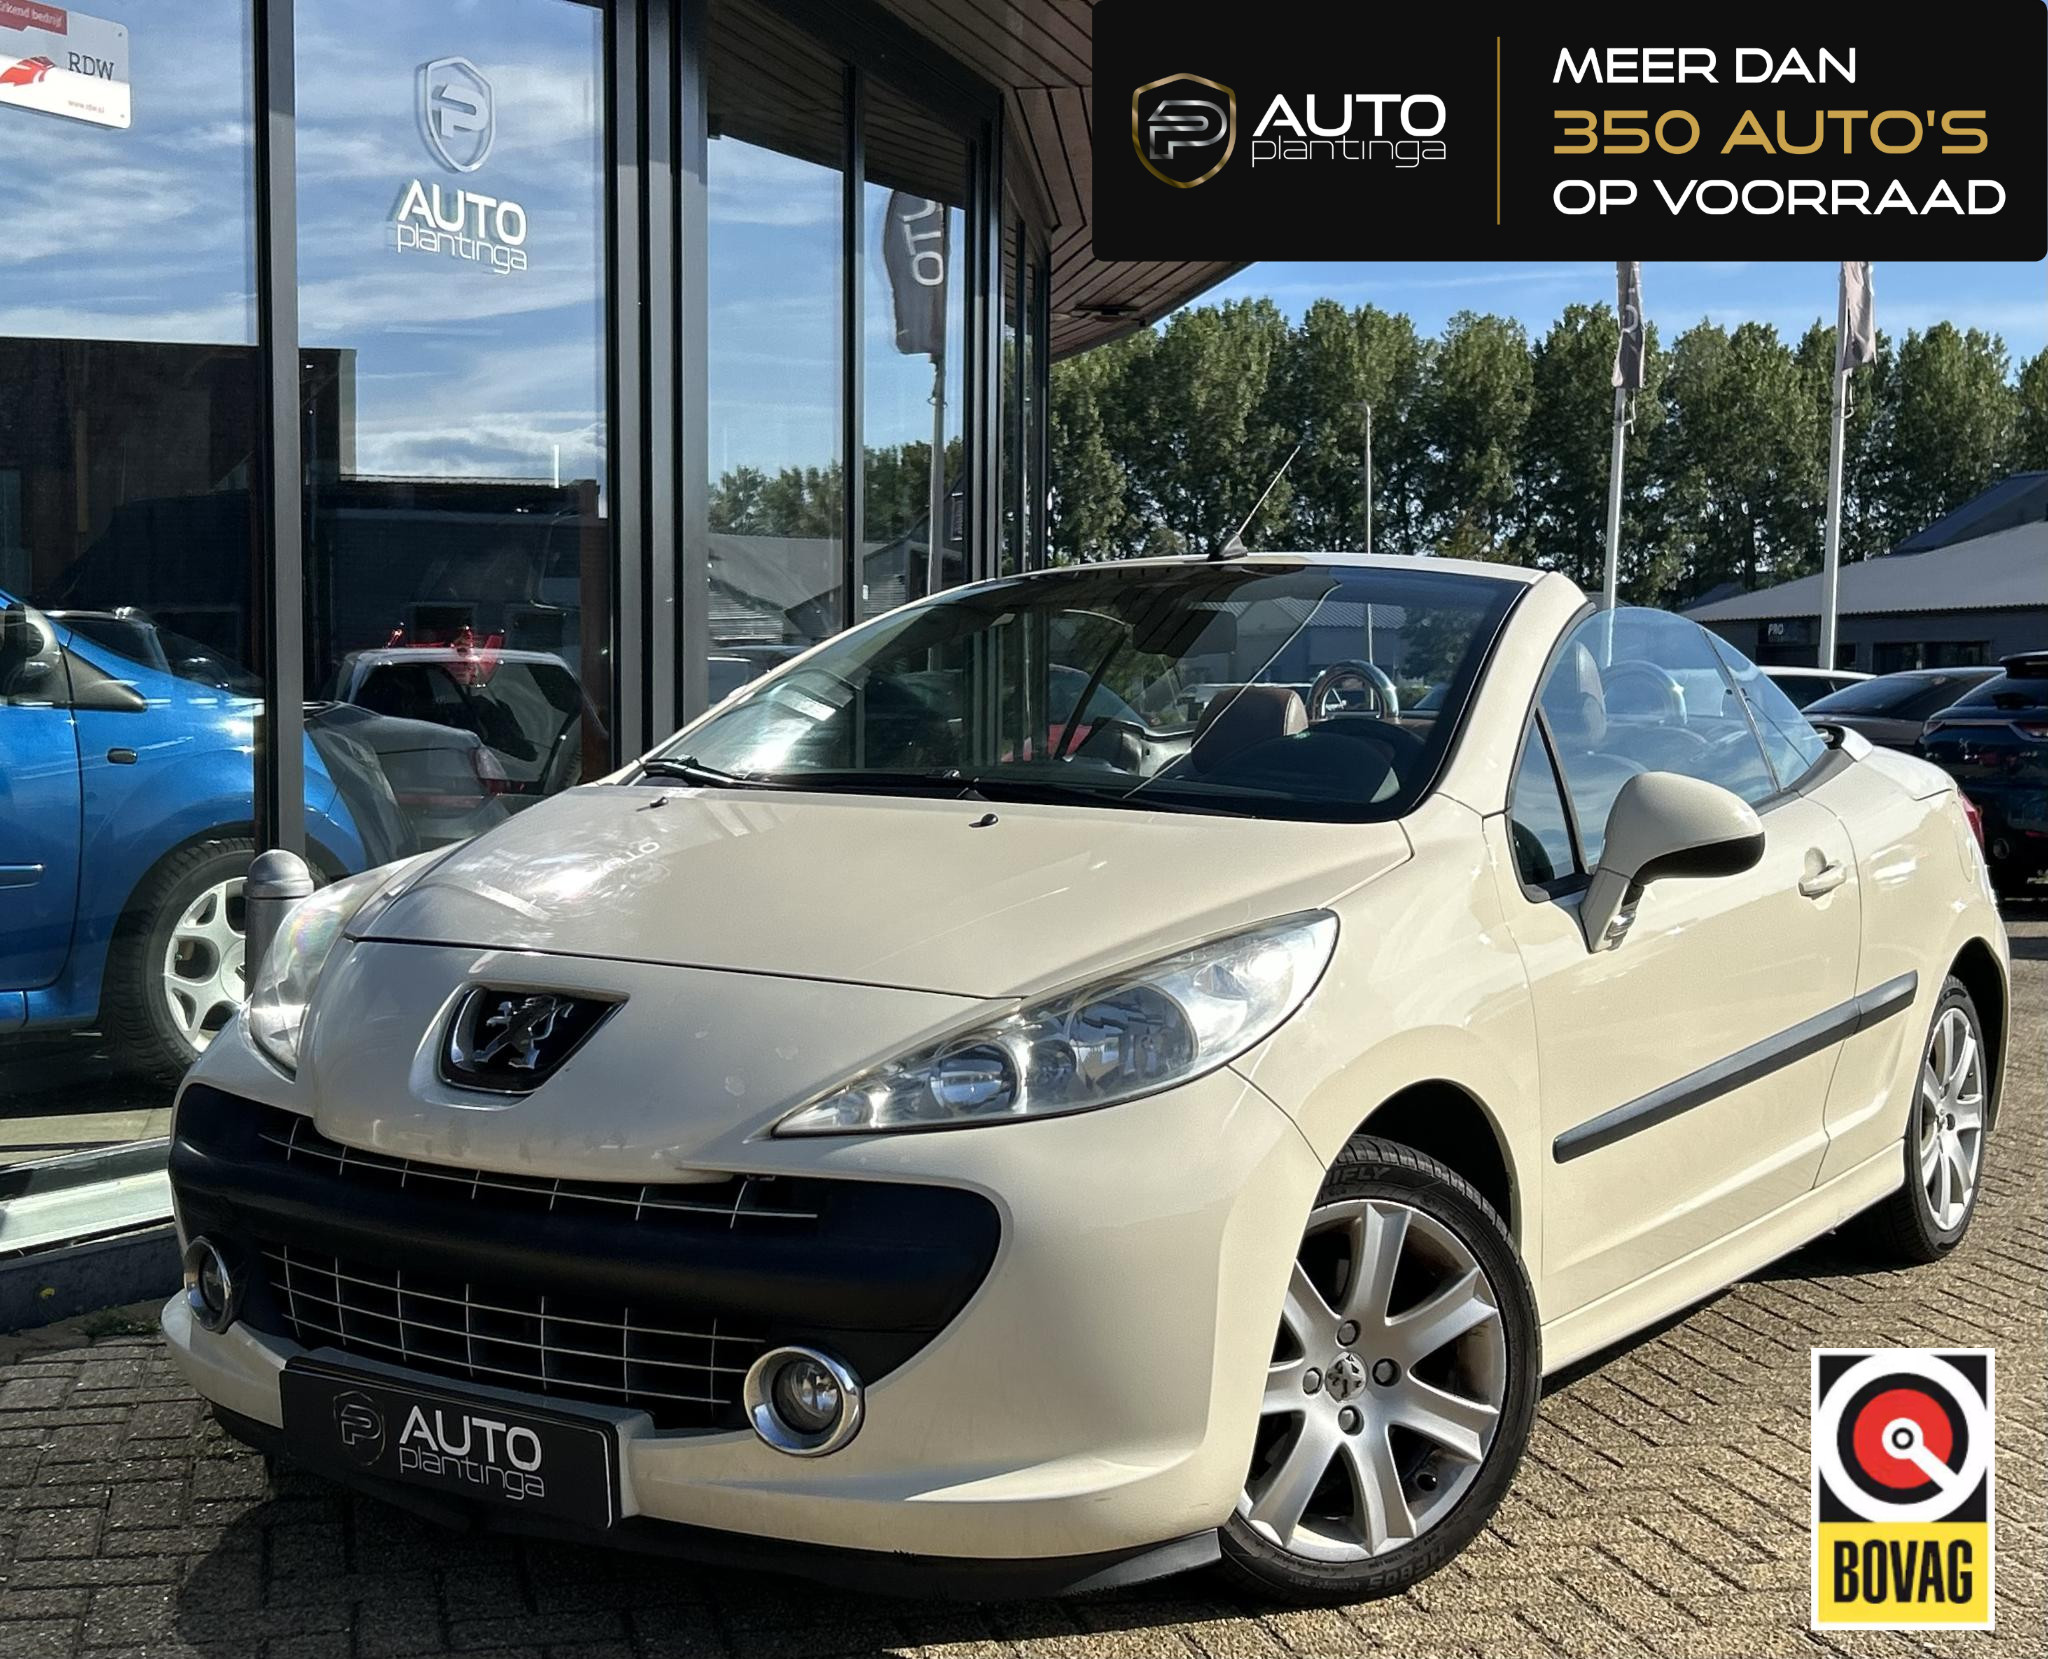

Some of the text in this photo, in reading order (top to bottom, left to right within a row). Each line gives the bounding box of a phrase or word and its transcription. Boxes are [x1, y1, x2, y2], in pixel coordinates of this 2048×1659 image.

[68, 51, 115, 81] RDW
[398, 178, 527, 246] AUTO
[397, 223, 528, 275] plantinga
[400, 1405, 542, 1472] AUTO
[400, 1446, 545, 1500] plantinga
